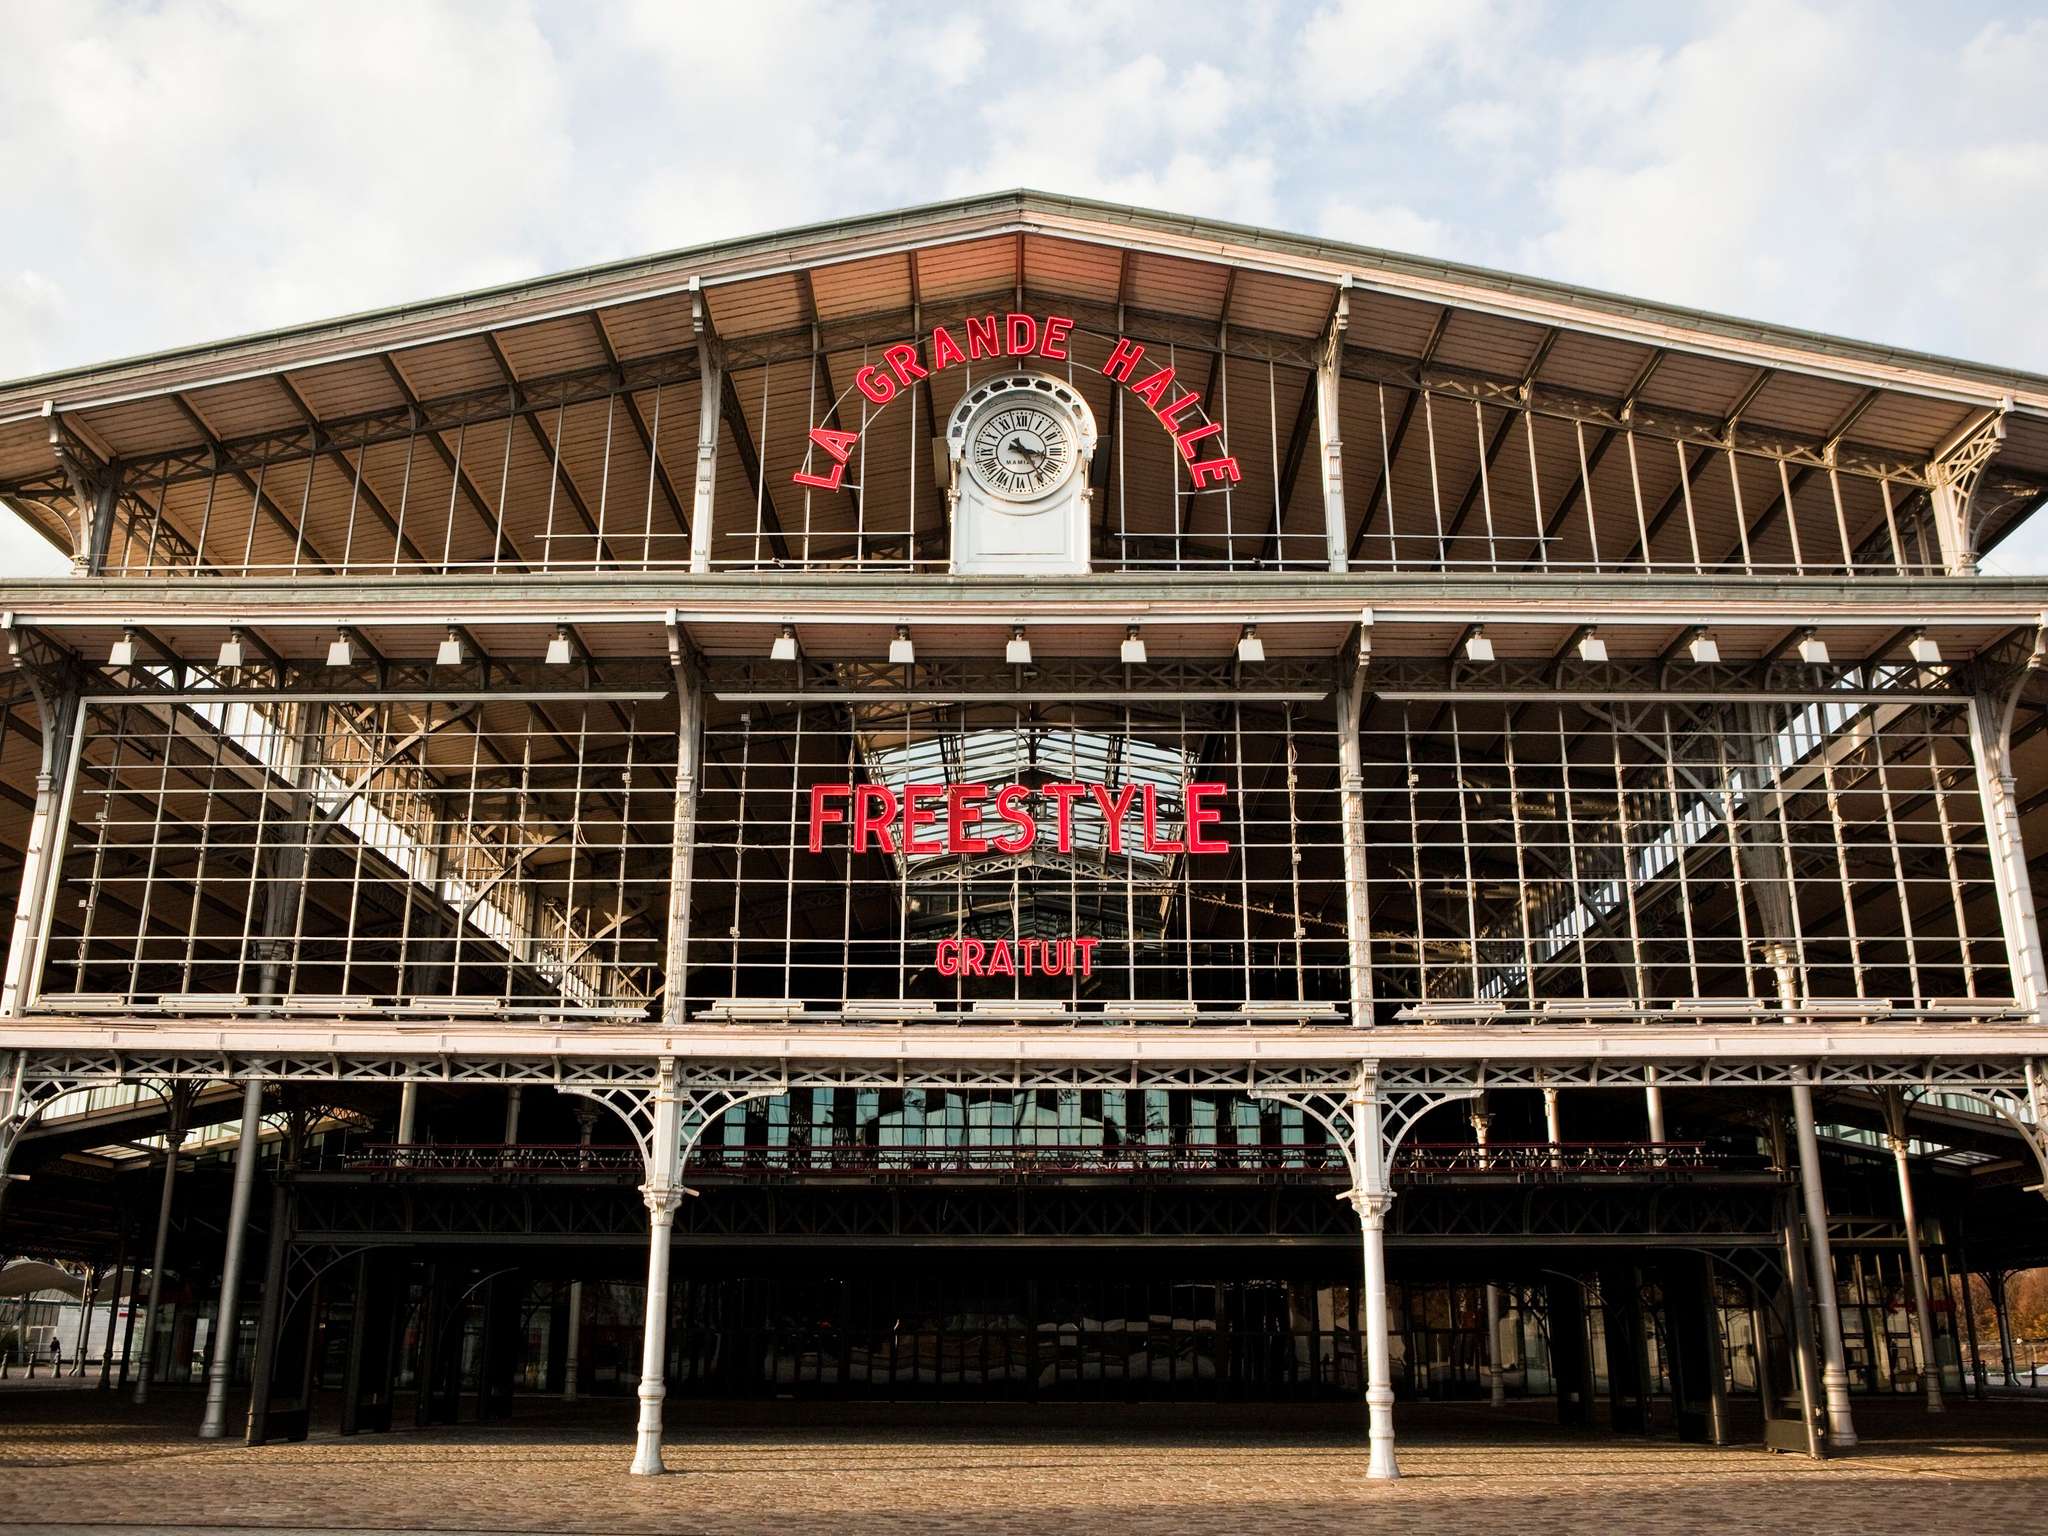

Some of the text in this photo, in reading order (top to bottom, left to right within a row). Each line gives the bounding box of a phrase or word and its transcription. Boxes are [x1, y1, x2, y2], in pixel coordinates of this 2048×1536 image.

[793, 313, 1243, 492] LA GRANDE HALLE
[808, 783, 1230, 854] FREESTYLE
[935, 936, 1099, 977] GRATUIT
